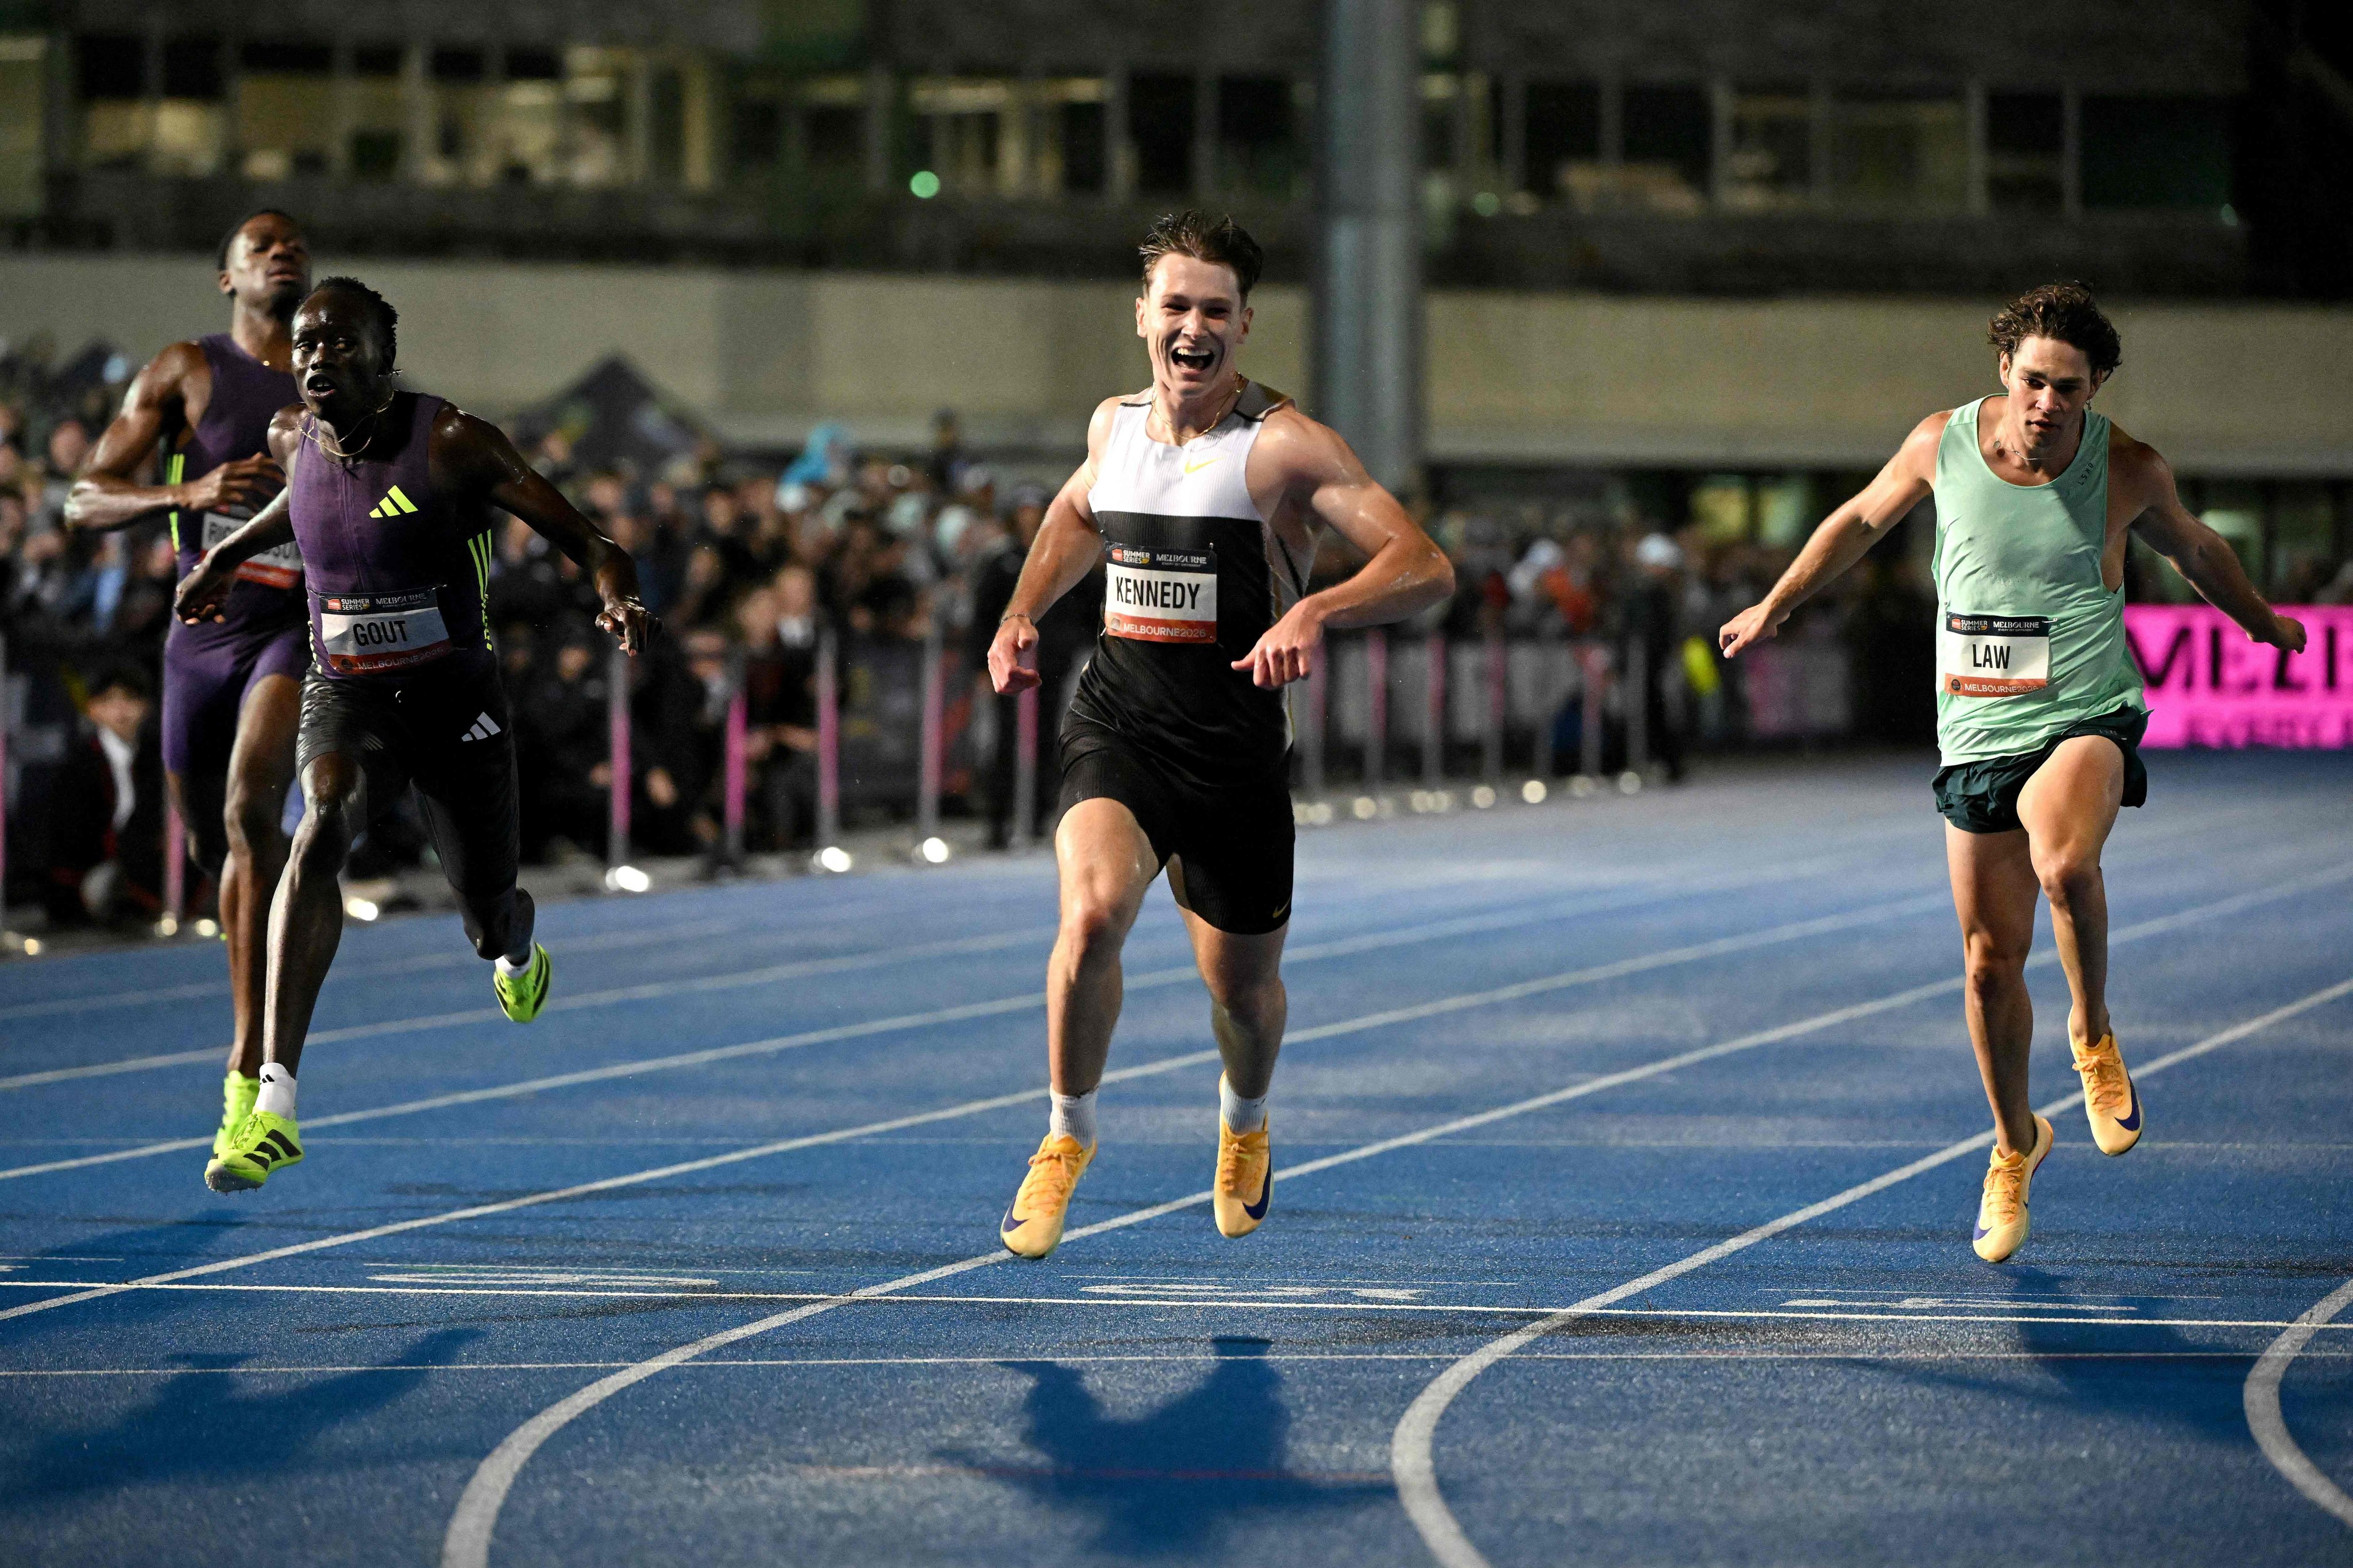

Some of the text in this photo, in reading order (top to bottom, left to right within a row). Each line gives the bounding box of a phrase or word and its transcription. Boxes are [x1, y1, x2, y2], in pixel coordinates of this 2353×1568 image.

[1123, 550, 1150, 558] SUMMER
[1123, 556, 1142, 564] SERIES
[1156, 554, 1206, 564] MELBOURNE
[1116, 576, 1200, 609] KENNEDY
[376, 593, 427, 605] MELBOURNE
[353, 620, 409, 647] GOUT
[1972, 644, 2011, 669] LAW
